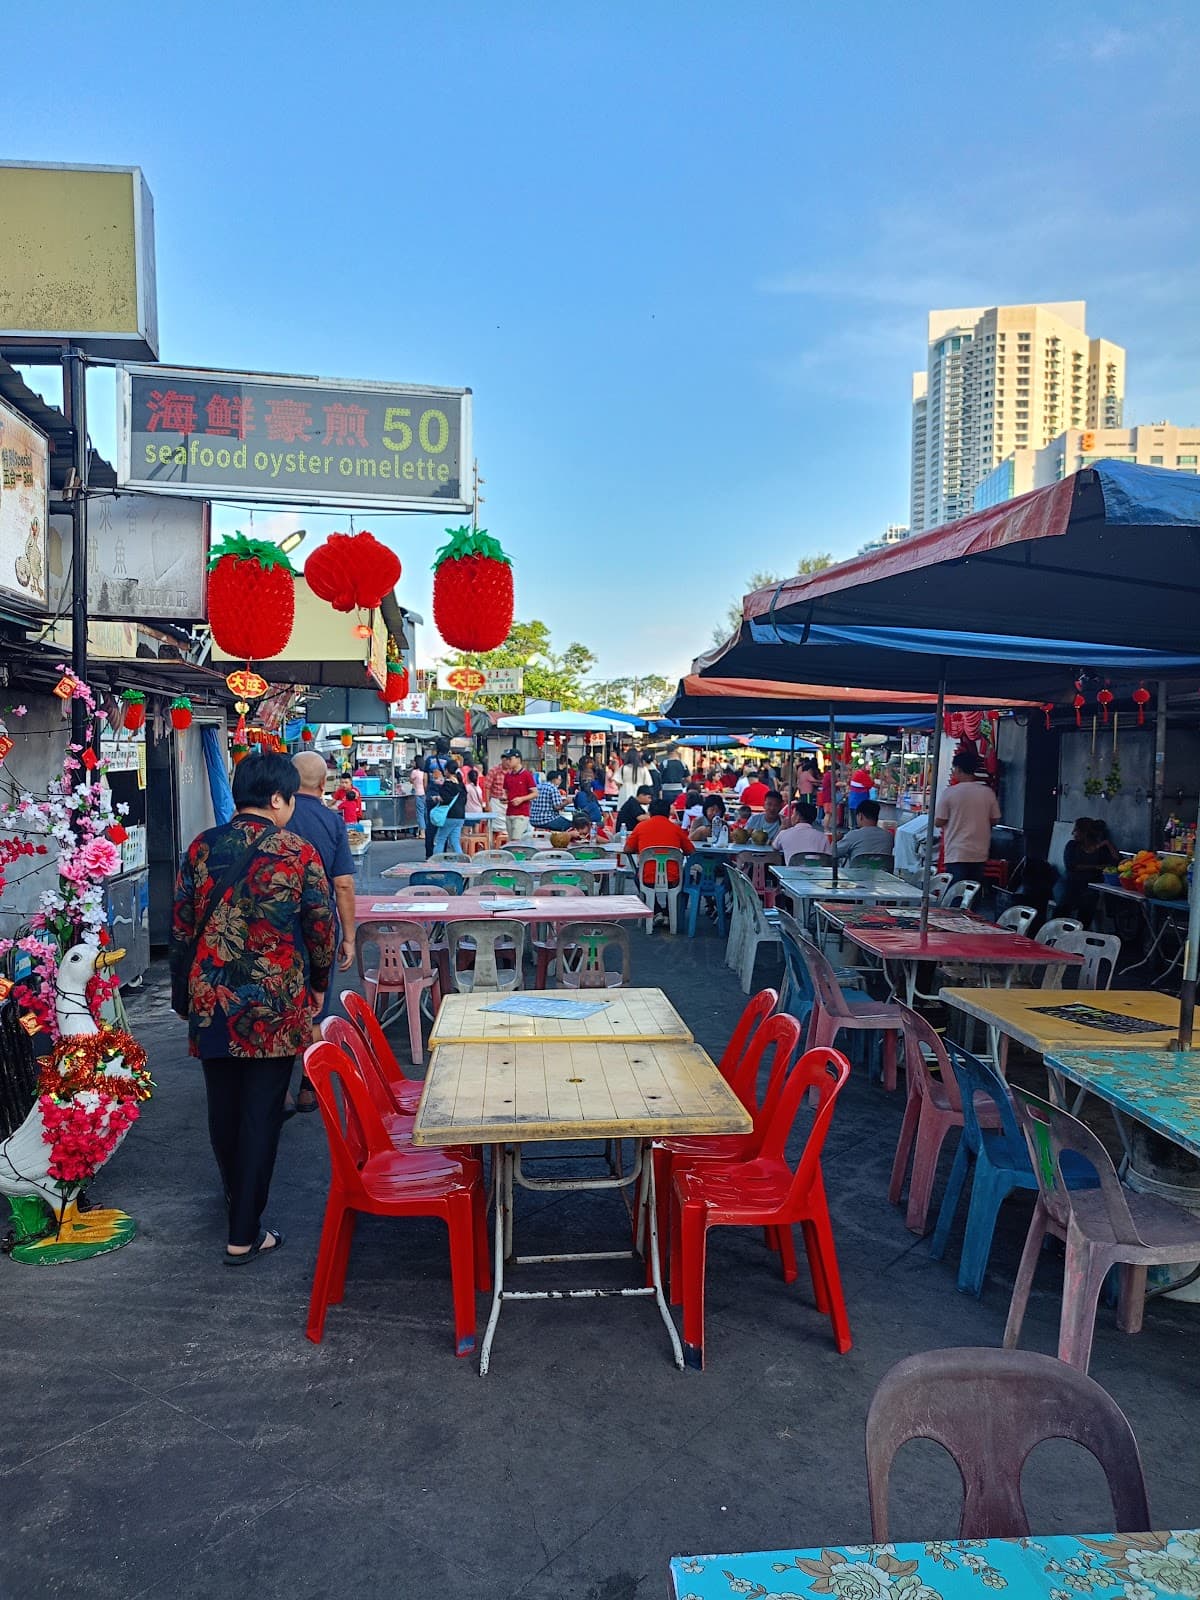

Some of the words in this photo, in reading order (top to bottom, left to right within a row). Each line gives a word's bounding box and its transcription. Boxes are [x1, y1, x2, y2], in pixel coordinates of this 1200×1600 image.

[382, 407, 450, 454] 50
[145, 439, 248, 471] seafood
[254, 447, 334, 478] oyster
[339, 455, 450, 482] omelette
[231, 675, 262, 692] 大旺
[451, 673, 482, 687] 大旺
